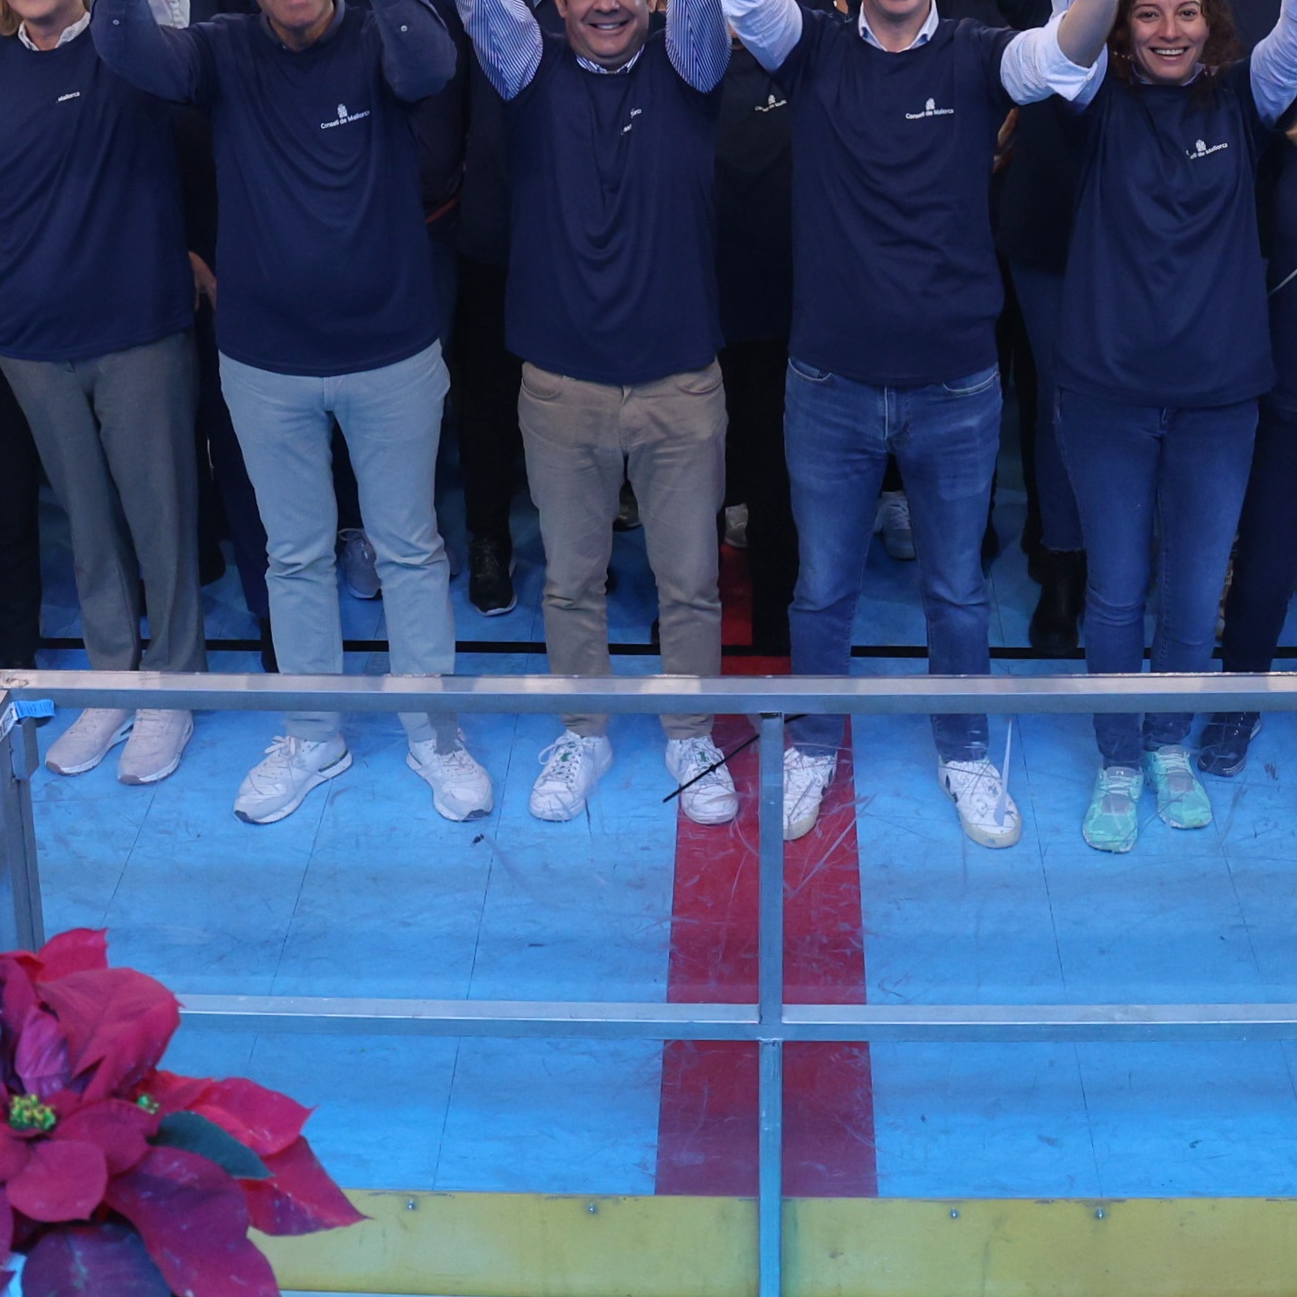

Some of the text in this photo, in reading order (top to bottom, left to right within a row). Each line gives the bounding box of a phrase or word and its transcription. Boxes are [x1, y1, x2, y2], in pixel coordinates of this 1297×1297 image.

[904, 111, 925, 120] Consell
[320, 118, 340, 130] Consell
[339, 117, 348, 125] de
[1205, 142, 1229, 155] Mallorca
